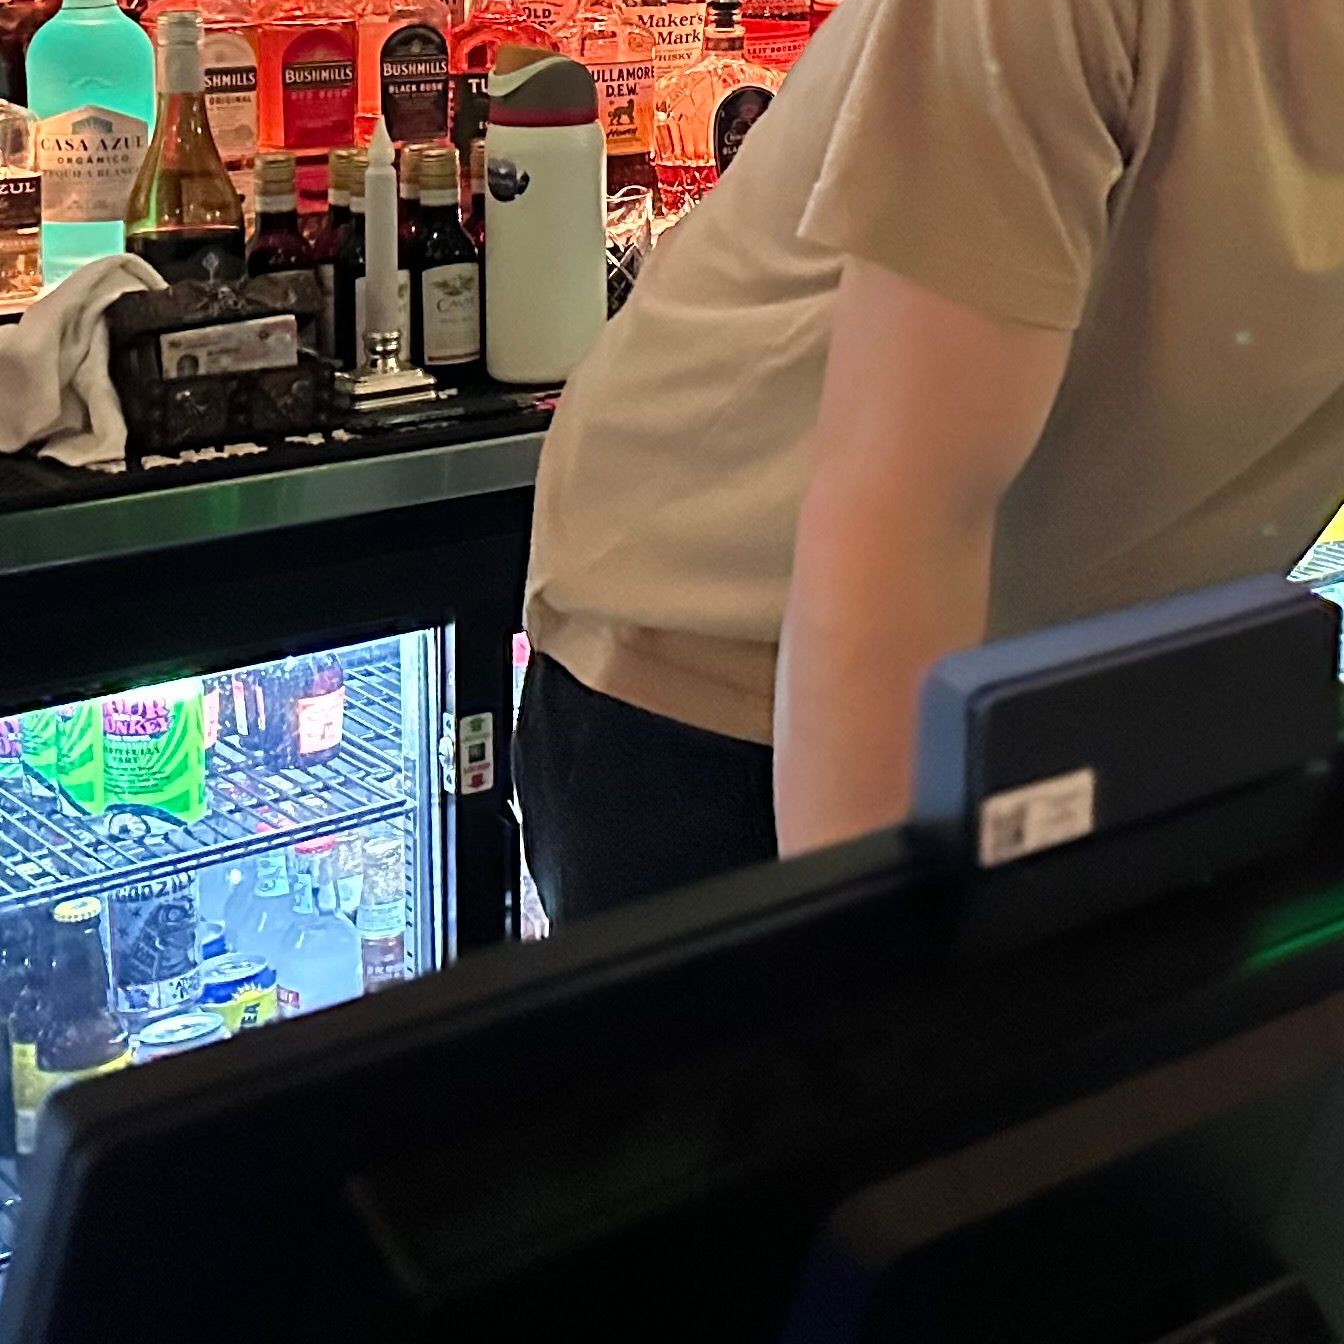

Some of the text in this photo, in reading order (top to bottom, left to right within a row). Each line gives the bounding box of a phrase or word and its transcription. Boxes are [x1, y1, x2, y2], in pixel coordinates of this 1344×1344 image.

[638, 13, 704, 29] Maker's
[656, 29, 702, 45] Mark
[285, 65, 353, 84] BUSHMILLS
[383, 60, 448, 77] BUSHMILLS
[204, 71, 256, 88] SHMILLS
[388, 83, 417, 94] BLACK
[41, 135, 144, 152] CASA AZUL
